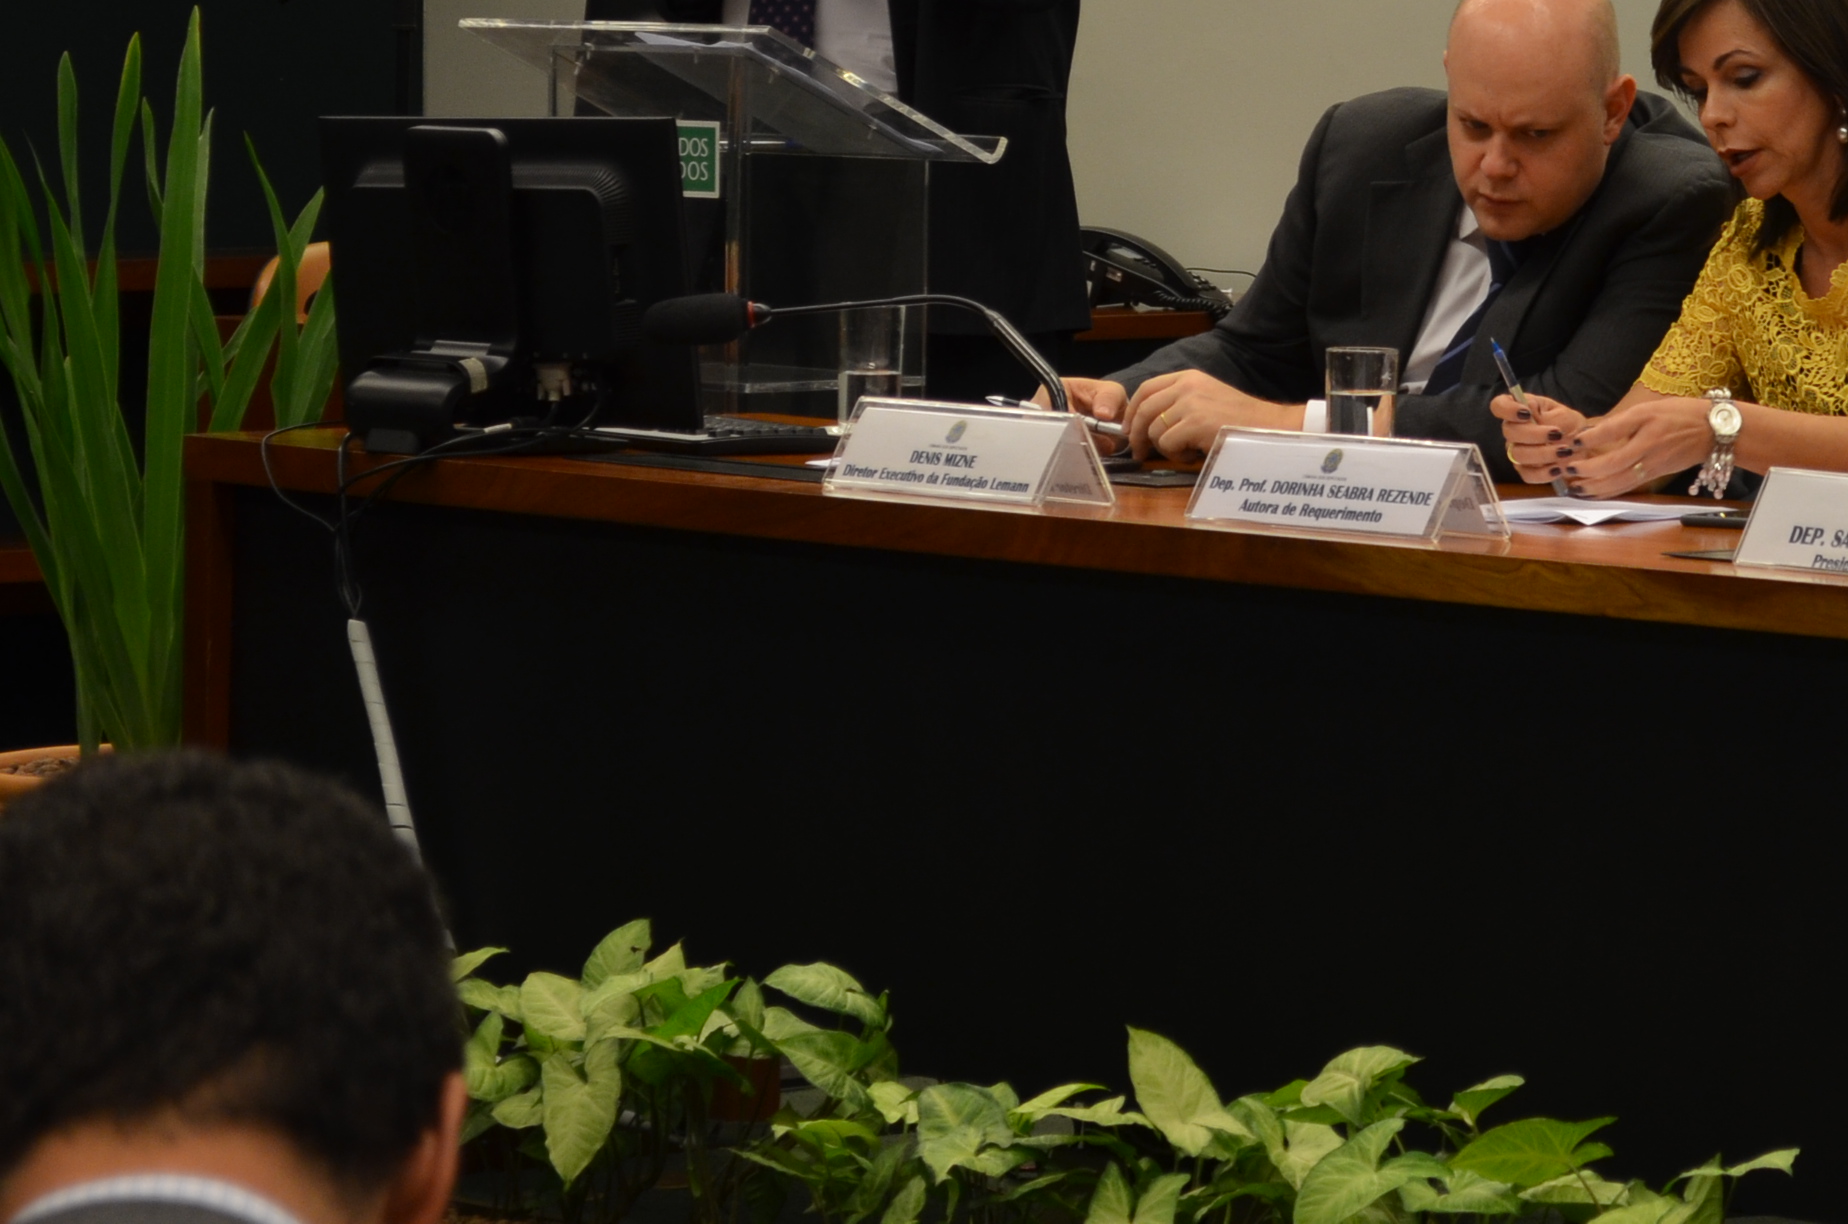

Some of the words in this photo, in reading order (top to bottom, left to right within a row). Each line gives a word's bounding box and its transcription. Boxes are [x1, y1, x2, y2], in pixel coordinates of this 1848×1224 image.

[909, 450, 942, 466] DENIS
[944, 453, 978, 469] MIZNE
[843, 463, 878, 479] Diretor
[879, 467, 924, 483] Executivo
[926, 471, 938, 483] da
[940, 473, 987, 491] Fundação
[990, 477, 1029, 493] Lemann
[1209, 476, 1234, 492] Dep.
[1238, 478, 1266, 494] Prof.
[1270, 480, 1325, 499] DORINHA
[1327, 484, 1374, 502] SEABRA
[1376, 488, 1435, 507] REZENDE
[1238, 499, 1279, 515] Autora
[1281, 502, 1297, 516] de
[1299, 505, 1383, 524] Requerimento
[1788, 525, 1825, 546] DEP.
